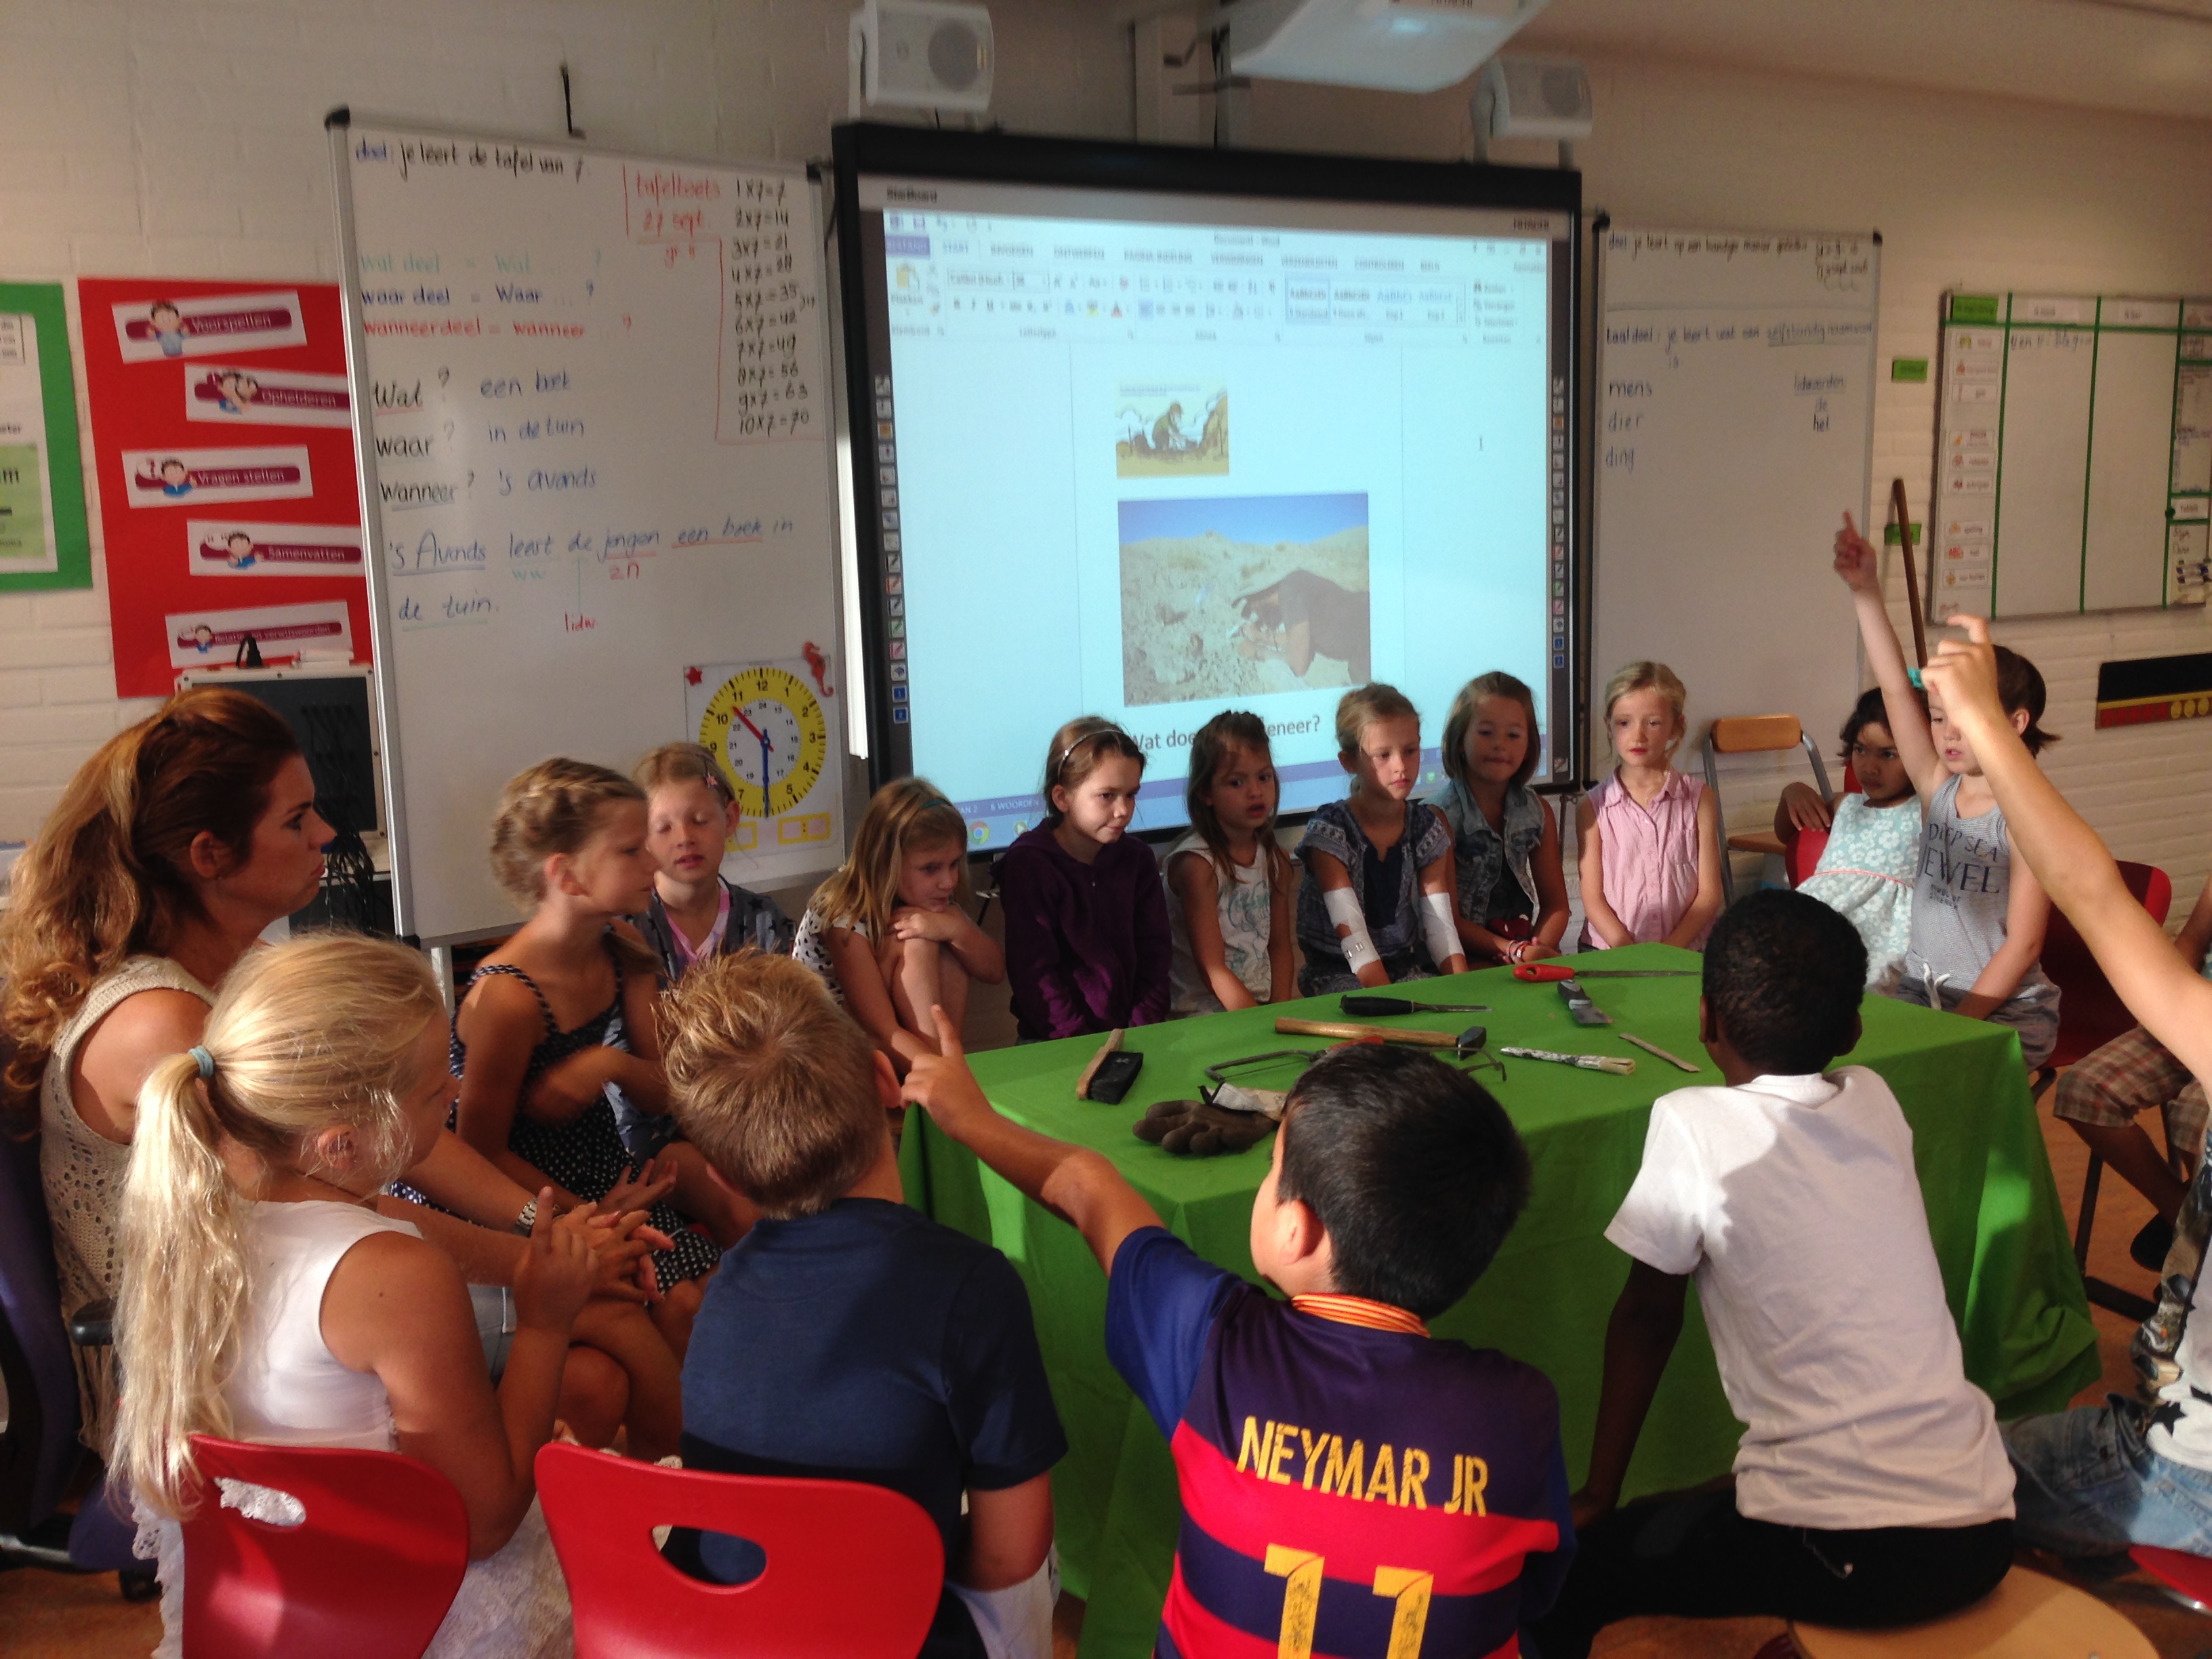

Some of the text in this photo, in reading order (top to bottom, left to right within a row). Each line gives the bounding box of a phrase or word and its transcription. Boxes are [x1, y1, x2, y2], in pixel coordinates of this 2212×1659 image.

[398, 139, 414, 182] je
[420, 139, 458, 167] leert
[468, 141, 487, 168] de
[495, 144, 533, 179] tafel
[539, 157, 564, 175] van
[413, 283, 450, 306] deel
[373, 377, 423, 408] Wat
[480, 377, 523, 398] een
[1609, 380, 1652, 398] mens
[488, 423, 507, 443] in
[546, 412, 585, 438] tuin
[1608, 409, 1644, 432] dier
[1605, 445, 1634, 474] ding
[197, 468, 285, 487] Vragen stellen
[568, 527, 593, 552] de
[678, 527, 708, 544] een
[773, 518, 794, 535] in
[268, 545, 345, 562] Samenvatten
[398, 595, 424, 621] de
[757, 680, 768, 691] 12
[785, 687, 790, 697] 1
[733, 691, 743, 702] 11
[716, 714, 729, 725] 10
[802, 705, 808, 718] 2
[733, 724, 741, 732] 22
[809, 732, 816, 743] 3
[1166, 729, 1195, 747] doe
[710, 741, 717, 754] 9
[735, 759, 743, 767] 20
[803, 761, 810, 772] 4
[777, 769, 784, 777] 17
[737, 788, 744, 800] 7
[786, 784, 793, 795] 5
[972, 805, 978, 813] 2
[998, 799, 1040, 811] WOORDEN
[1235, 1415, 1489, 1517] NEYMAR JR
[1263, 1542, 1435, 1659] 11
